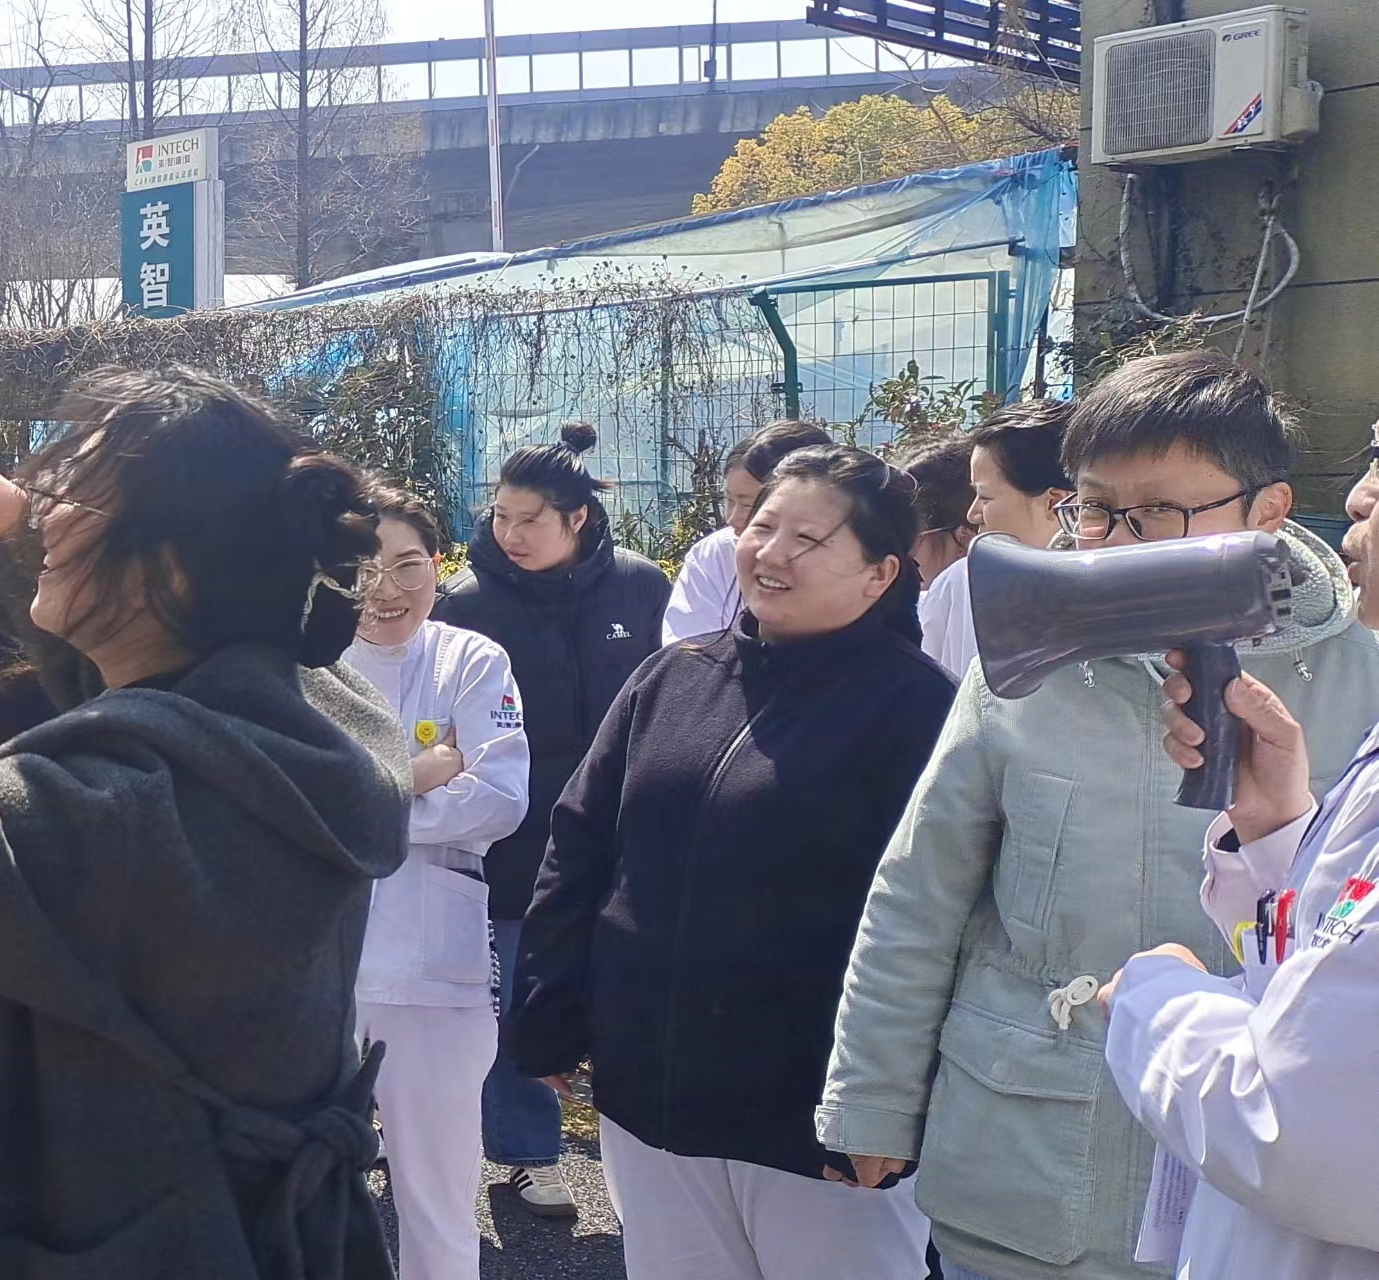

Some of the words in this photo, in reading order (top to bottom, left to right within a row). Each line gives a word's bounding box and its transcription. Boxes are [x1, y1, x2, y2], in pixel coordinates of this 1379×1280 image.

[1233, 29, 1261, 41] GREE
[158, 136, 199, 157] INTECH
[139, 200, 170, 309] 英智
[606, 630, 632, 640] CAMEL
[1315, 912, 1365, 945] ITECH
